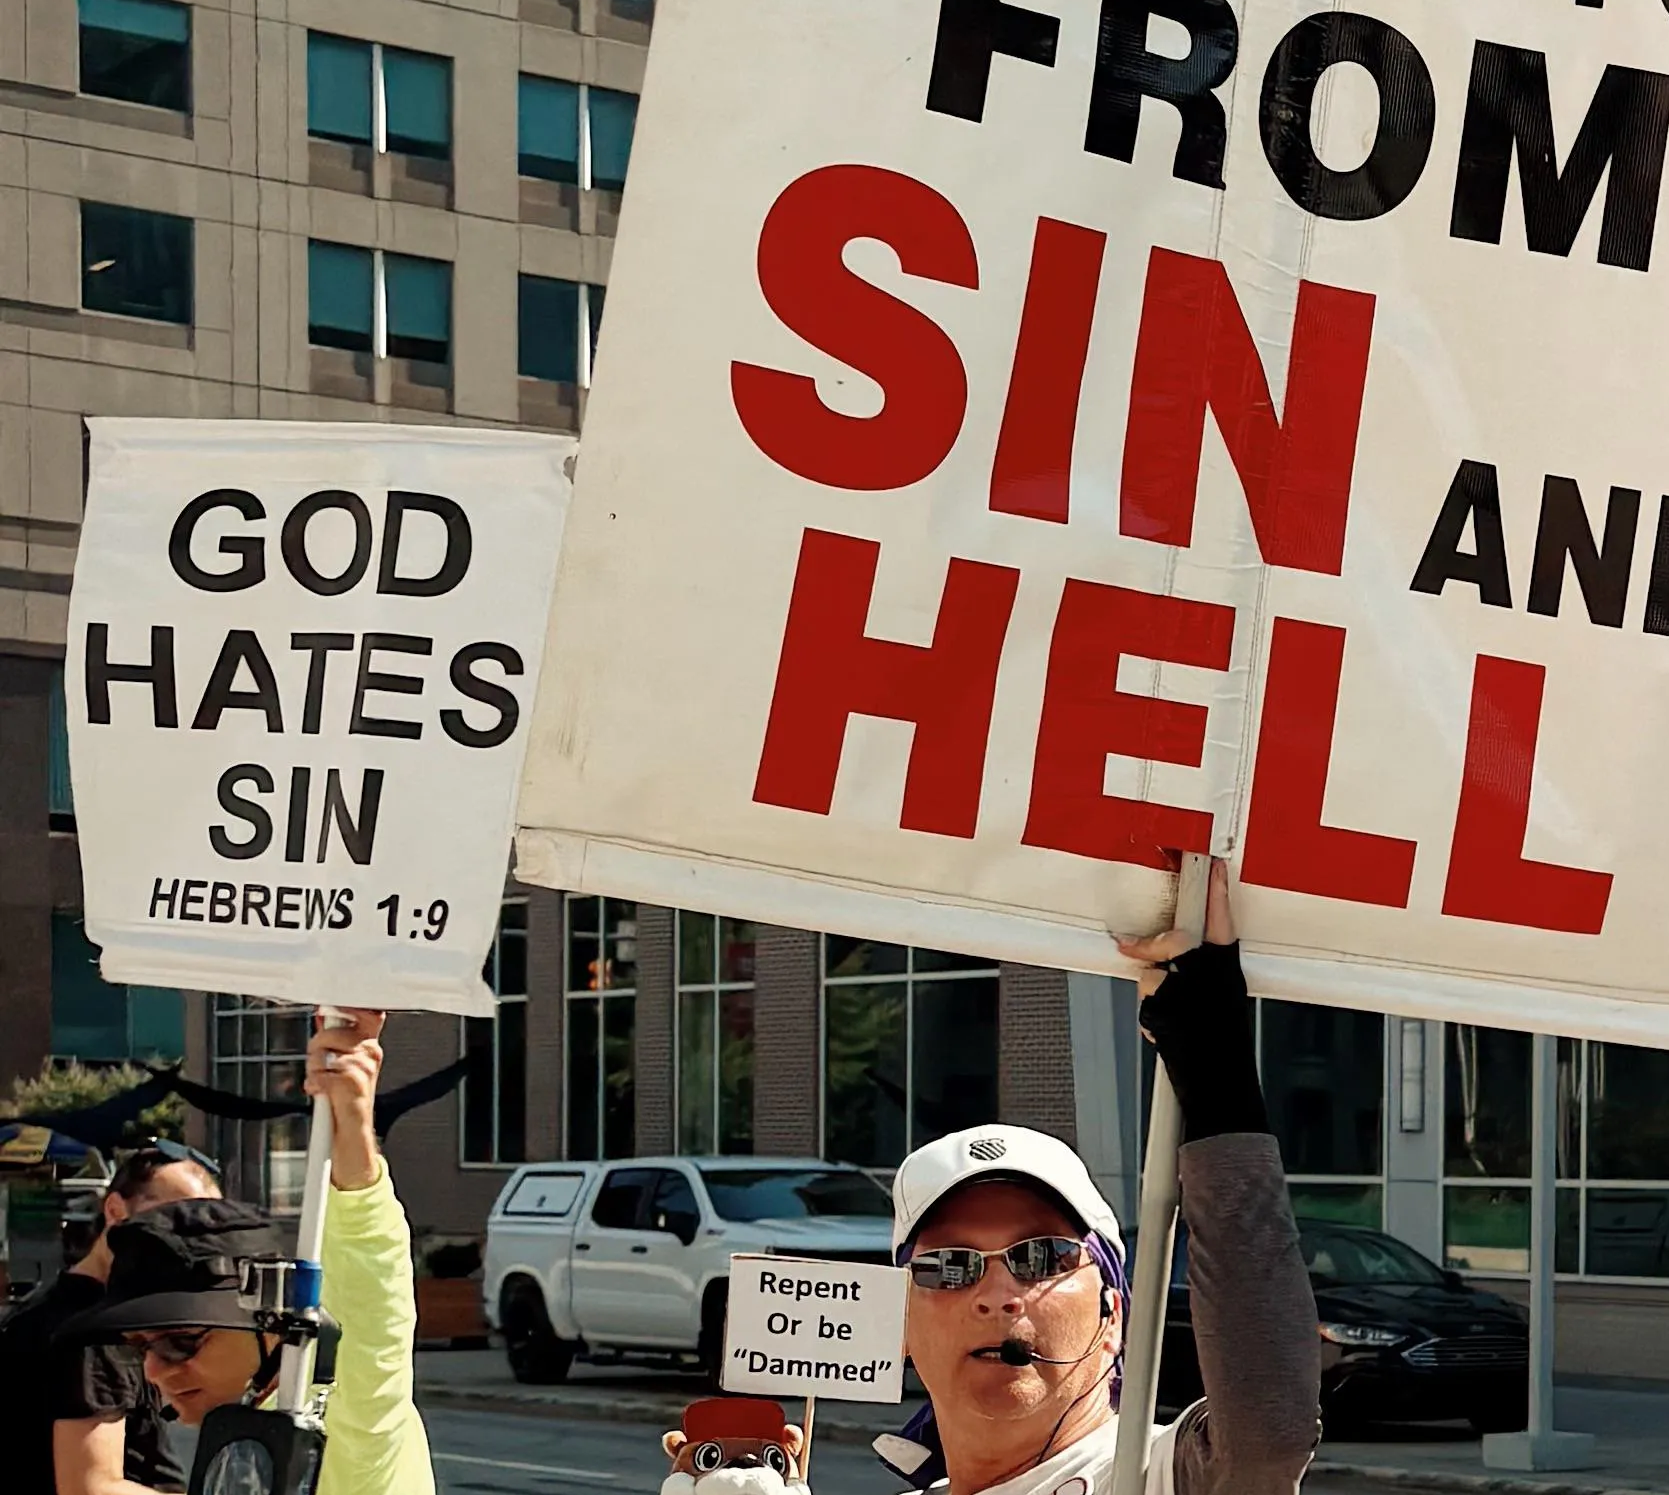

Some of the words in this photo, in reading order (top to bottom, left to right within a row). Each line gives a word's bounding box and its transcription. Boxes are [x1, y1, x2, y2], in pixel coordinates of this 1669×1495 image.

[730, 162, 1377, 578] SIN
[168, 488, 473, 598] GOD
[84, 622, 525, 749] HATES
[750, 526, 1616, 936] HELL
[208, 763, 385, 866] SIN
[148, 877, 354, 931] HEBREWS
[376, 893, 450, 942] 1:9
[759, 1271, 861, 1302] Repent
[767, 1312, 802, 1336] Or
[818, 1314, 853, 1341] be
